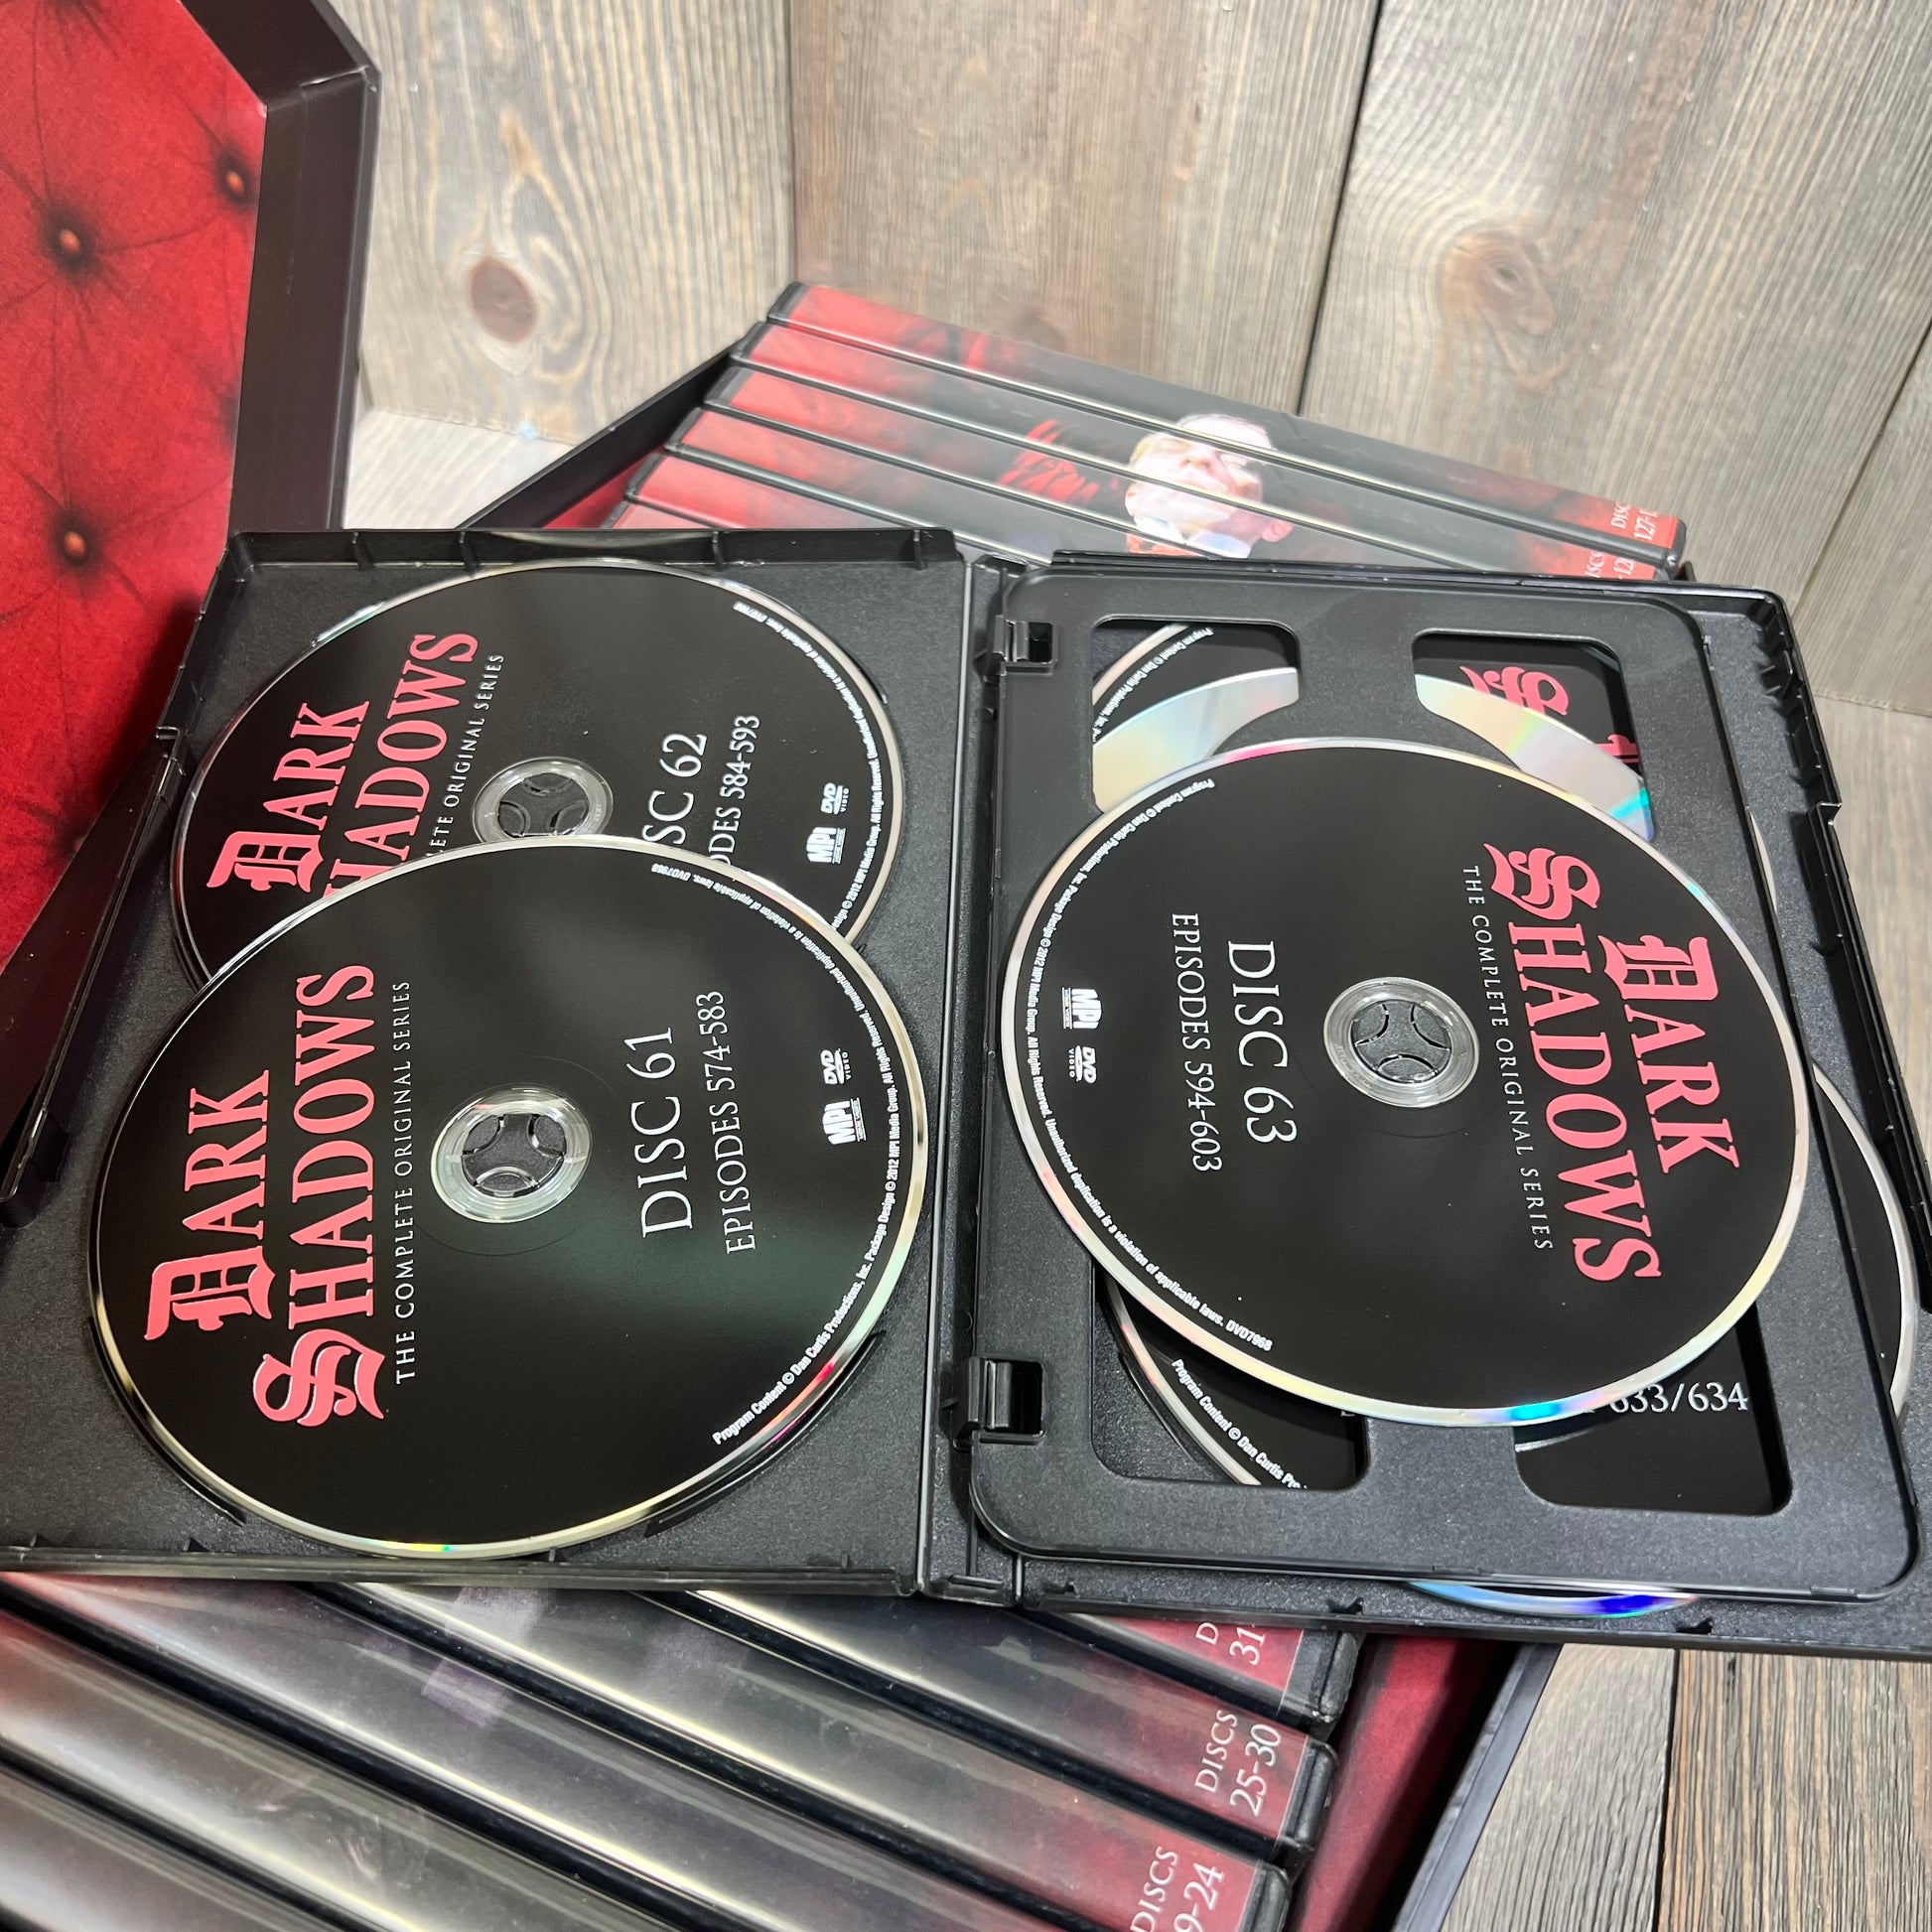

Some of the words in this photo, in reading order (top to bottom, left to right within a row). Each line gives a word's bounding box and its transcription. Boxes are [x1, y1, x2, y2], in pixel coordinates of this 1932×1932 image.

[444, 718, 485, 808] ORIGINAL
[474, 654, 504, 711] SERIES
[659, 733, 708, 777] 62
[719, 715, 760, 800] 584-593
[207, 701, 370, 893] DARK
[641, 790, 695, 845] SC
[820, 782, 837, 814] DVD
[806, 826, 837, 863] MPI
[1462, 866, 1485, 905] THE
[831, 908, 849, 931] esign
[1031, 965, 1043, 983] MPI
[1034, 946, 1048, 967] 2012
[1471, 913, 1509, 1028] COMPLETE
[1028, 983, 1040, 1008] Media
[1172, 912, 1211, 1050] EPISODES
[392, 981, 410, 1051] SERIES
[1026, 1008, 1037, 1035] Group.
[1071, 989, 1102, 1030] MPI
[1227, 940, 1289, 1068] DISC
[623, 1028, 676, 1079] 61
[696, 991, 735, 1092] 574-583
[876, 1046, 892, 1072] Rights
[1027, 1048, 1041, 1076] Rights
[1028, 1036, 1039, 1048] All
[1483, 843, 1662, 1282] SHADOWS
[1597, 934, 1740, 1173] DARK
[820, 1049, 837, 1084] DVD
[842, 1051, 852, 1081] VIDEO
[883, 1072, 895, 1084] All
[1082, 1046, 1097, 1084] DVD
[887, 1084, 898, 1113] Group.
[1033, 1075, 1052, 1119] Reserved.
[1184, 1060, 1223, 1172] 594-603
[1243, 1086, 1298, 1143] 63
[1495, 1036, 1534, 1157] ORIGINAL
[392, 1060, 413, 1177] ORIGINAL
[822, 1100, 856, 1145] MPI
[889, 1112, 899, 1139] Media
[630, 1096, 693, 1238] DISC
[889, 1138, 899, 1158] MPI
[708, 1100, 757, 1254] EPISODES
[887, 1159, 899, 1180] 2012
[143, 1069, 276, 1340] DARK
[252, 964, 386, 1427] SHADOWS
[878, 1192, 896, 1223] Design
[1070, 1172, 1106, 1219] duplication
[1519, 1167, 1554, 1251] SERIES
[865, 1220, 888, 1262] Package
[1101, 1214, 1113, 1227] is
[1108, 1224, 1118, 1234] a
[393, 1187, 416, 1317] COMPLETE
[1114, 1230, 1149, 1267] violation
[1146, 1262, 1160, 1275] of
[856, 1262, 873, 1280] Inc.
[1155, 1271, 1201, 1310] applicable
[824, 1281, 865, 1334] Productions,
[1198, 1303, 1224, 1327] laws.
[805, 1330, 831, 1358] Curtis
[1225, 1319, 1273, 1351] DVD7968
[395, 1330, 416, 1384] THE
[790, 1355, 811, 1376] Dan
[752, 1381, 787, 1416] Content
[1172, 1359, 1203, 1400] Program
[1199, 1396, 1232, 1432] Content
[1237, 1436, 1258, 1458] Dan
[1255, 1451, 1284, 1479] Curtis
[712, 1410, 755, 1446] Program
[1193, 1710, 1239, 1794] DISCS
[1229, 1724, 1282, 1817] 25-30
[1130, 1846, 1177, 1932] DISCS
[1173, 1863, 1224, 1932] 9-24
